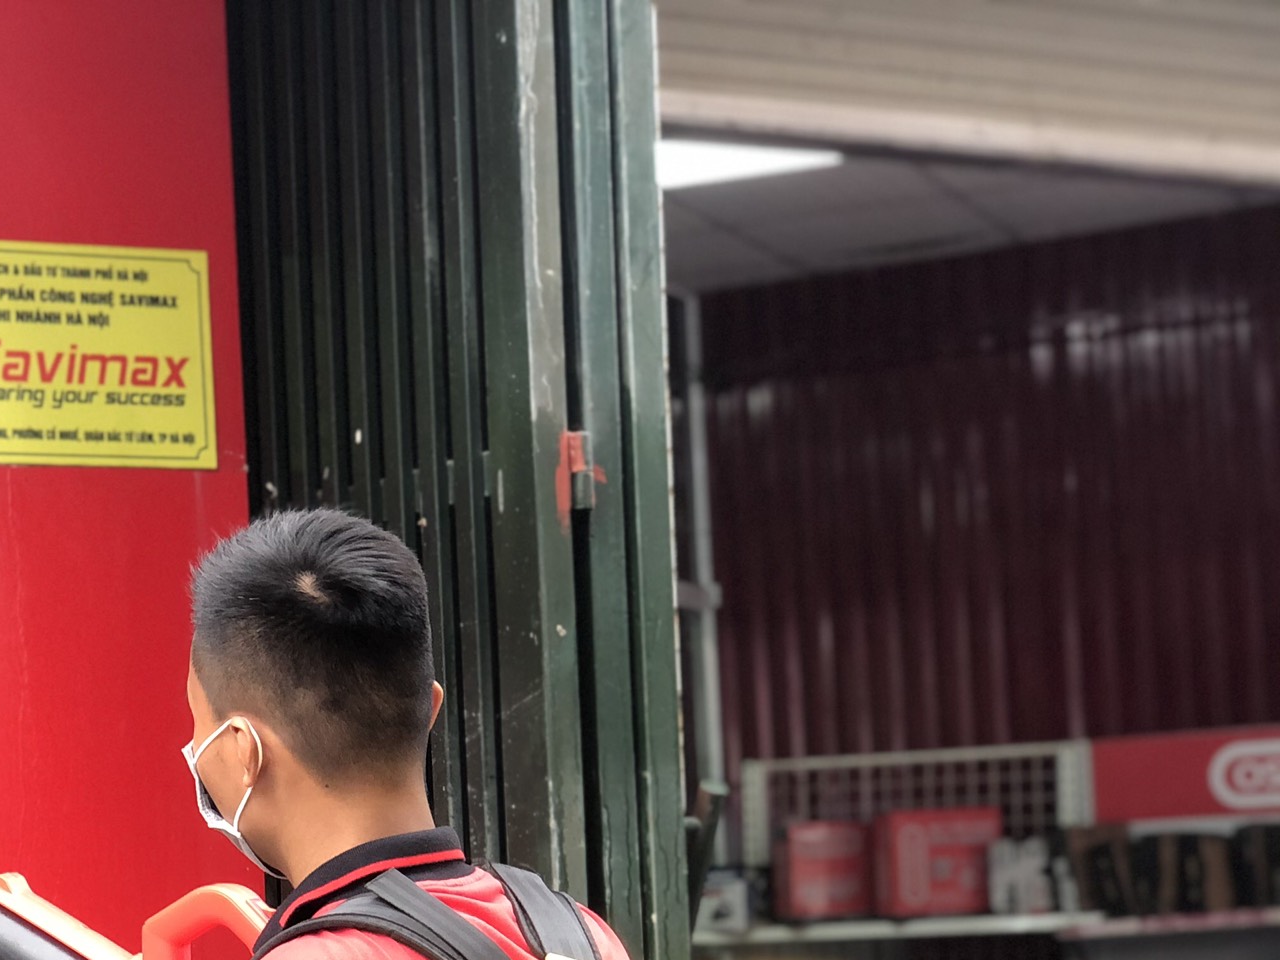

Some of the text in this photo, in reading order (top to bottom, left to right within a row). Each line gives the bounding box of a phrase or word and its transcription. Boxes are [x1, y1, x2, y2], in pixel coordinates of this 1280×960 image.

[40, 287, 75, 302] CÔNG
[120, 294, 178, 308] SAVIMAX
[66, 309, 83, 325] HÀ
[87, 312, 110, 328] NỘI
[52, 389, 98, 408] your
[105, 391, 186, 407] success
